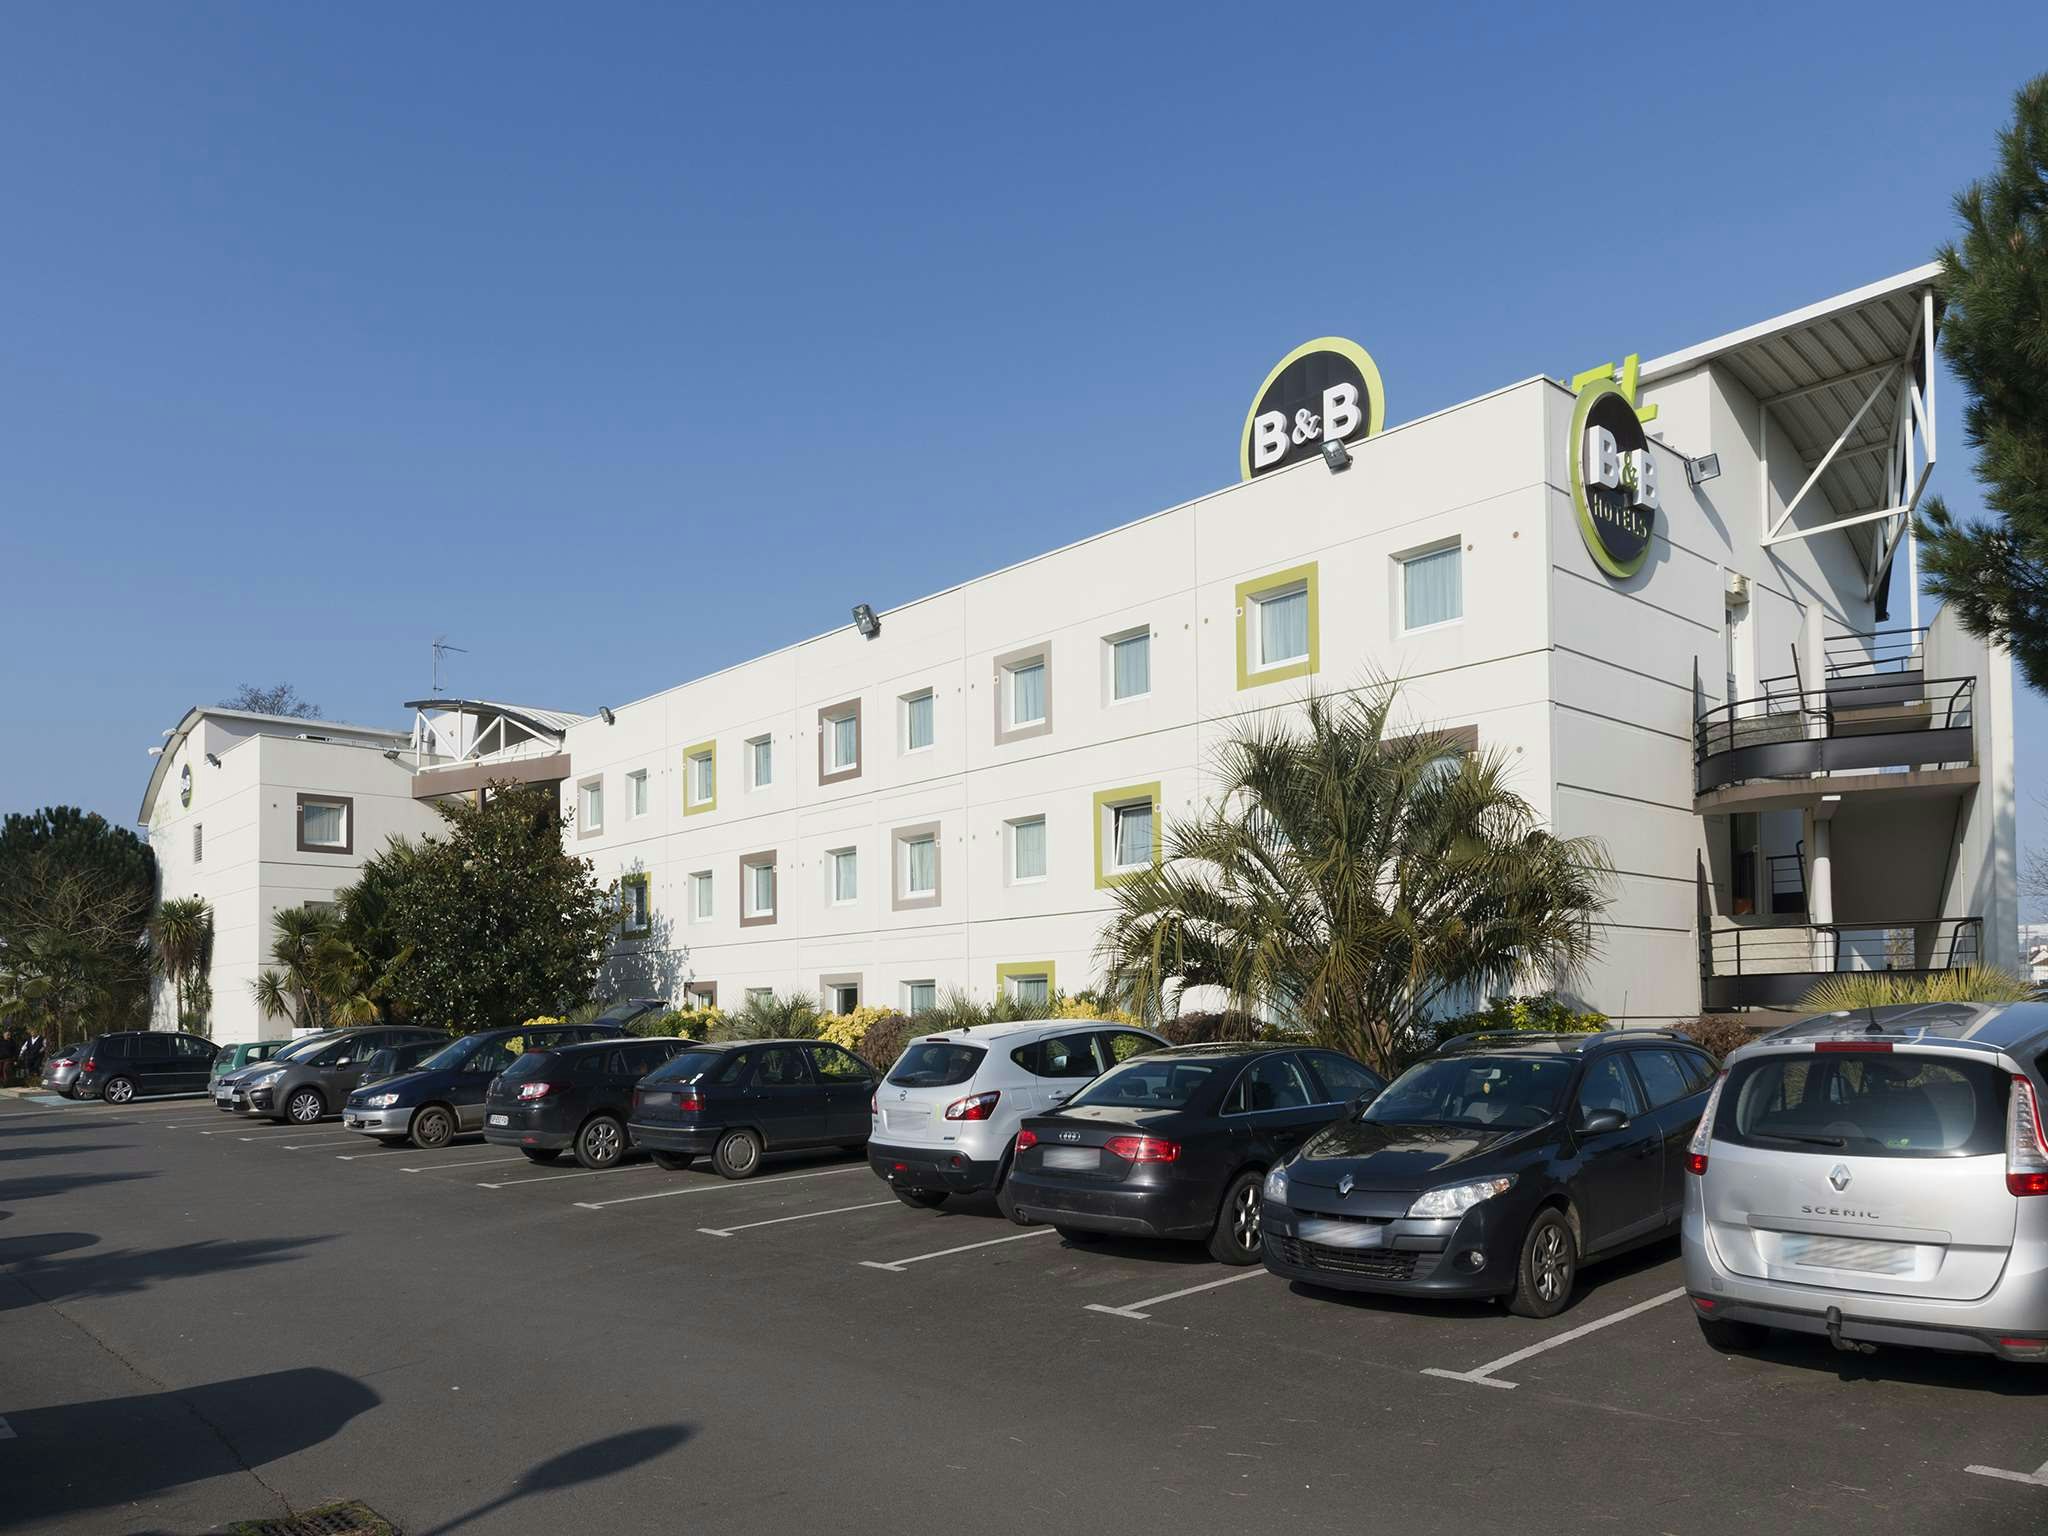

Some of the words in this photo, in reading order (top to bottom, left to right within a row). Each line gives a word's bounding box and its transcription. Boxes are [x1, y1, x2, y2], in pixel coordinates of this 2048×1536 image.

[1254, 382, 1362, 469] B&B
[1584, 424, 1658, 510] B&B
[1593, 493, 1647, 538] HOTELS
[1801, 1206, 1879, 1219] SCENIC
